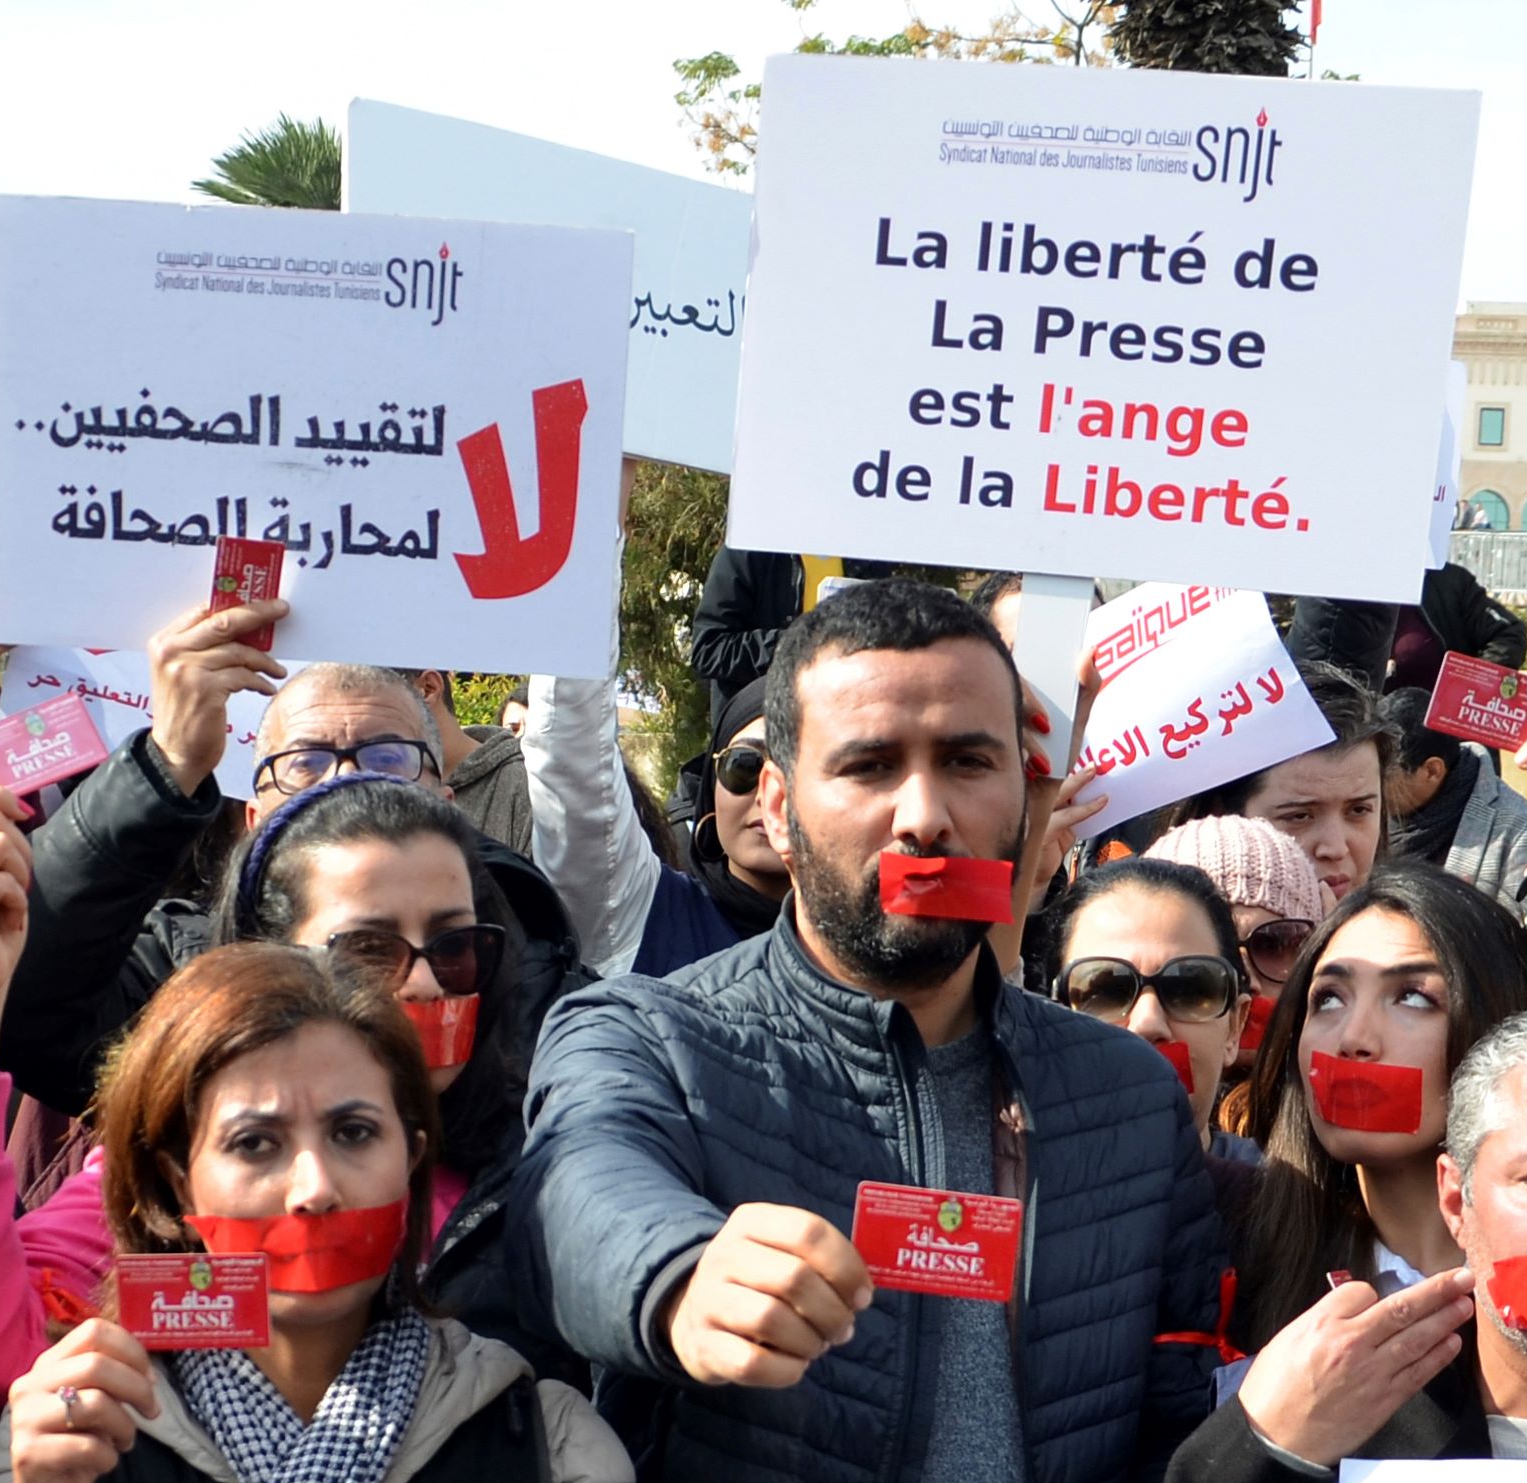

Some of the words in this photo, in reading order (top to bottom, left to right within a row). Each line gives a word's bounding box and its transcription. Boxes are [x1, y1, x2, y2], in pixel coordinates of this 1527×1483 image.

[938, 142, 988, 166] Syndicat
[989, 146, 1038, 167] National
[1039, 149, 1060, 168] des
[1061, 150, 1133, 172] Journalistes
[1135, 153, 1189, 175] Tunisiens
[1083, 125, 1142, 146] الوطنية
[1192, 106, 1283, 203] snjt
[875, 217, 950, 270] La
[977, 221, 1206, 285] liberté
[1233, 235, 1320, 293] de
[155, 272, 200, 291] Syndicat
[202, 275, 244, 294] National
[246, 278, 266, 295] des
[267, 279, 332, 298] Journalistes
[334, 282, 382, 301] Tunisiens
[385, 242, 463, 326] snjt
[930, 299, 1007, 354] La
[1033, 303, 1267, 371] Presse
[294, 402, 447, 469] لتقييد
[907, 380, 1014, 433] est
[1038, 383, 1250, 461] l'ange
[51, 482, 247, 547] الصحافة
[453, 379, 589, 599] لا
[851, 448, 931, 502] de
[957, 455, 1016, 512] la
[1041, 461, 1312, 534] Liberté.
[263, 497, 441, 570] لمحاربة
[1458, 705, 1523, 737] PRESSE
[1461, 689, 1527, 722] صحافة
[10, 743, 73, 780] PRESSE
[896, 1247, 986, 1277] PRESSE
[906, 1223, 980, 1254] صحافة
[150, 1290, 235, 1311] صحافة
[152, 1310, 236, 1330] PRESSE
